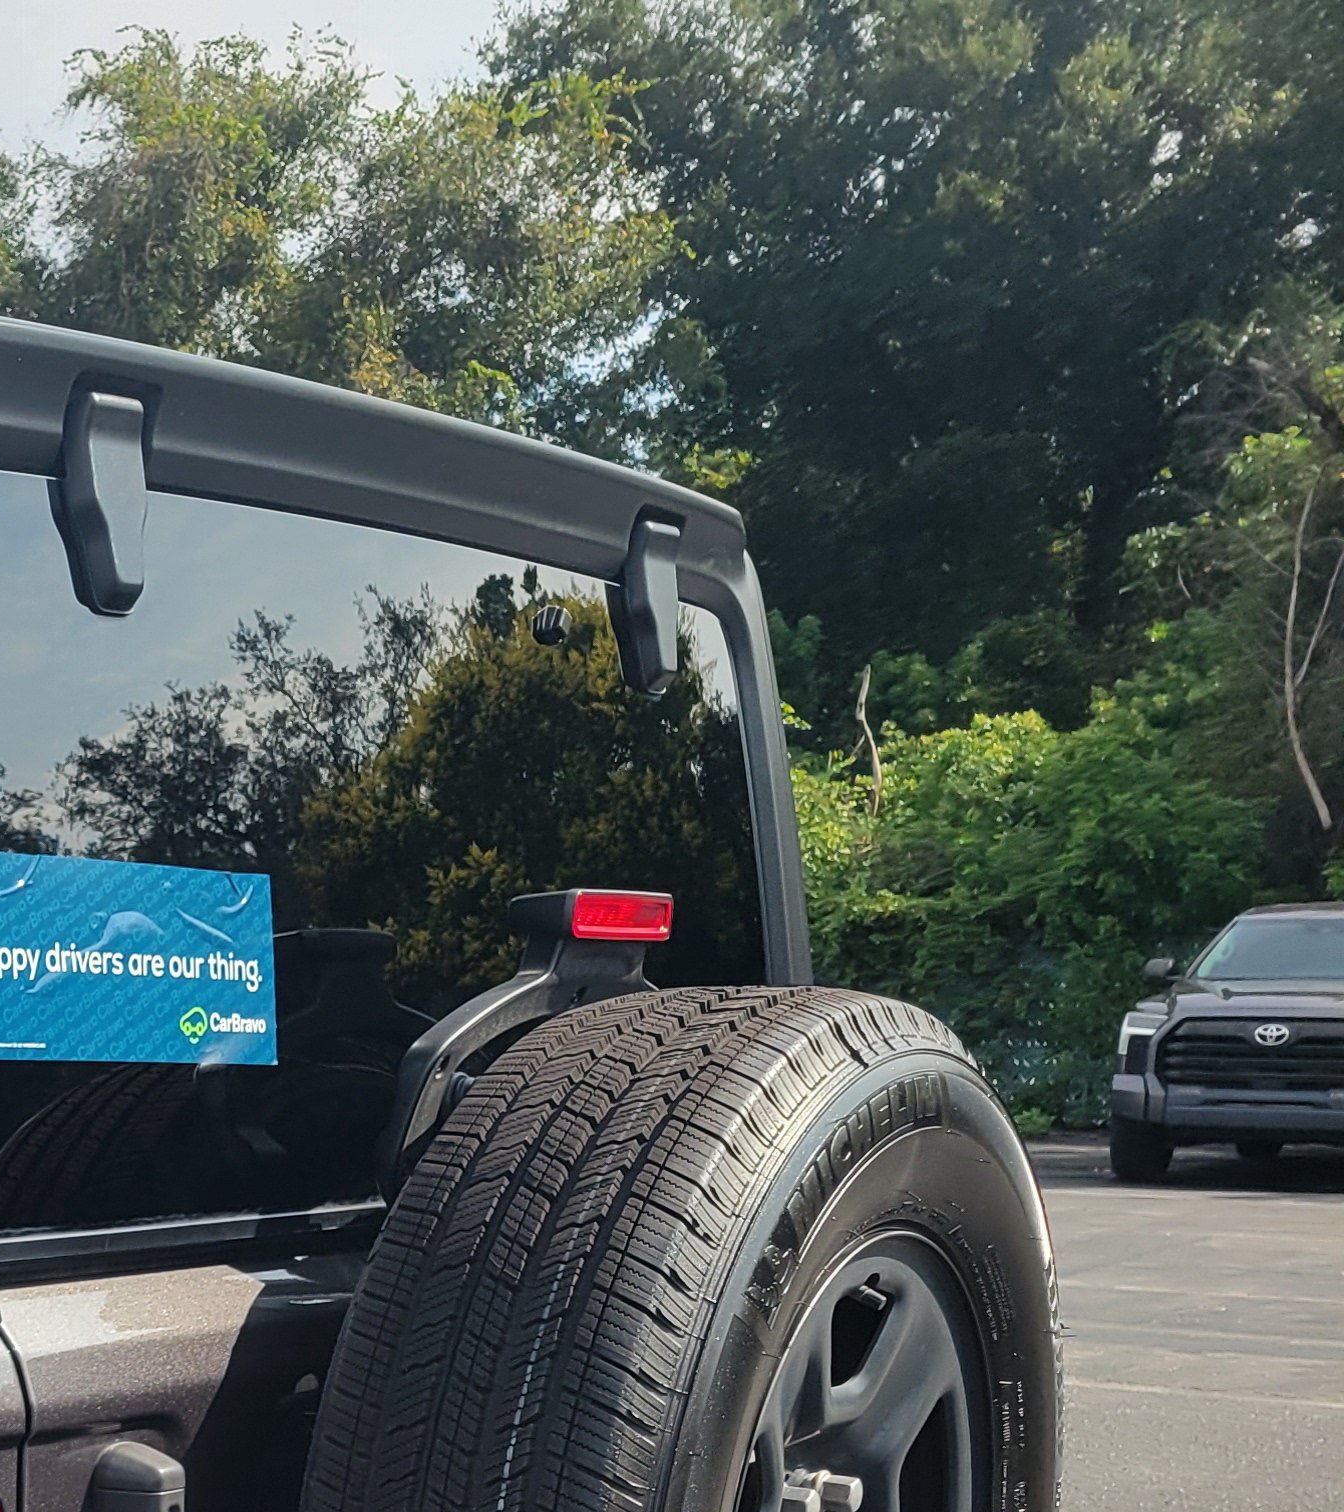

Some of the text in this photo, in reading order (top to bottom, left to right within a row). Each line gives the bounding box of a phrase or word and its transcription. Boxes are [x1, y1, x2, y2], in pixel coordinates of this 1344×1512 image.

[45, 941, 124, 976] drivers
[128, 955, 164, 978] are
[168, 956, 205, 980] our
[208, 950, 263, 993] thing.
[209, 1011, 267, 1035] CarBravo
[786, 1074, 942, 1249] MICHELIN
